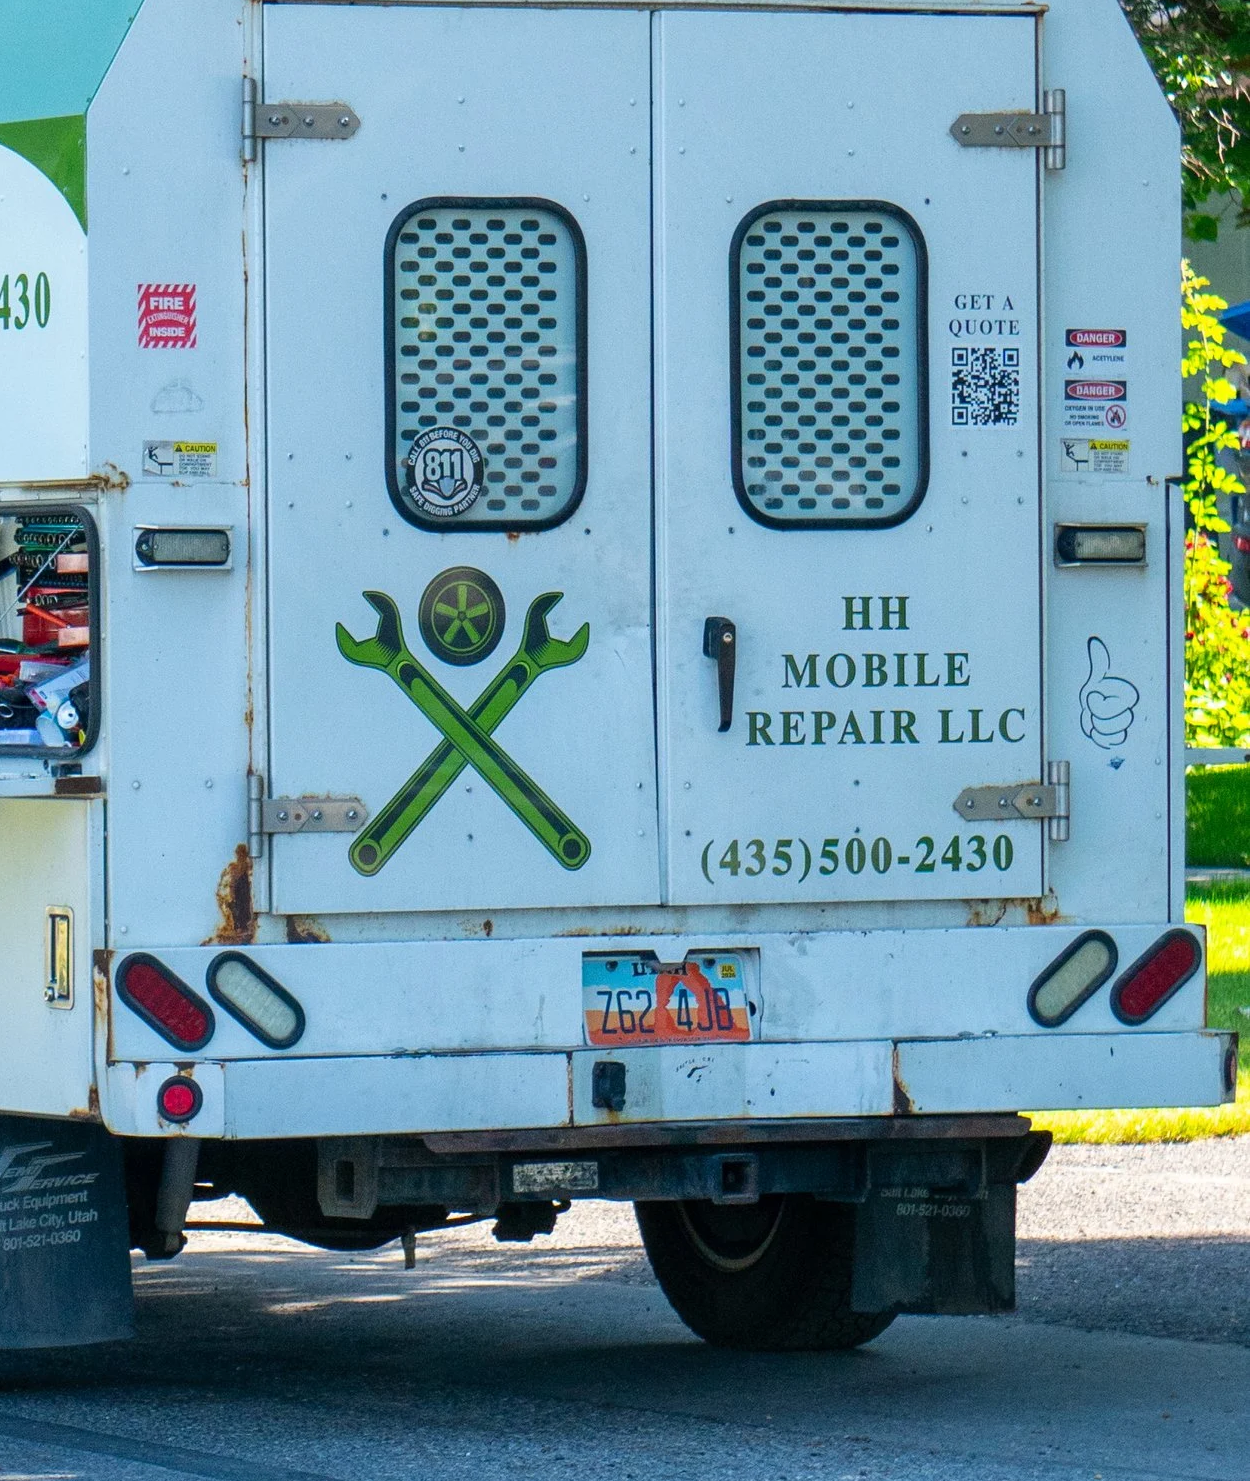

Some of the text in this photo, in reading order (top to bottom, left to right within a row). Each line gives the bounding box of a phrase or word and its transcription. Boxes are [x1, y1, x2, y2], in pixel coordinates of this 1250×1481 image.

[149, 297, 184, 310] FIRE
[954, 294, 1014, 310] GET A
[149, 326, 186, 337] INSIDE
[949, 319, 1020, 338] QUOTE
[1076, 332, 1116, 343] DANGER
[1076, 385, 1116, 396] DANGER
[184, 445, 216, 453] CAUTION
[408, 430, 481, 466] CALL 811 BEFORE YOU DIG
[1099, 442, 1129, 450] CAUTION
[424, 449, 464, 481] 811
[410, 484, 481, 516] SAFE DIGGING PARTNER
[841, 596, 910, 630] HH
[781, 652, 971, 688] MOBILE
[745, 708, 1026, 746] REPAIR LLC
[701, 834, 1014, 884] (435)500-2430
[597, 987, 734, 1034] Z62 4JB
[22, 1190, 88, 1211] Equipment
[896, 1203, 971, 1217] 801-521-0360
[9, 1217, 37, 1230] Lake
[39, 1214, 65, 1229] City,
[68, 1209, 98, 1224] Utah
[3, 1229, 82, 1251] 801-521-0360
